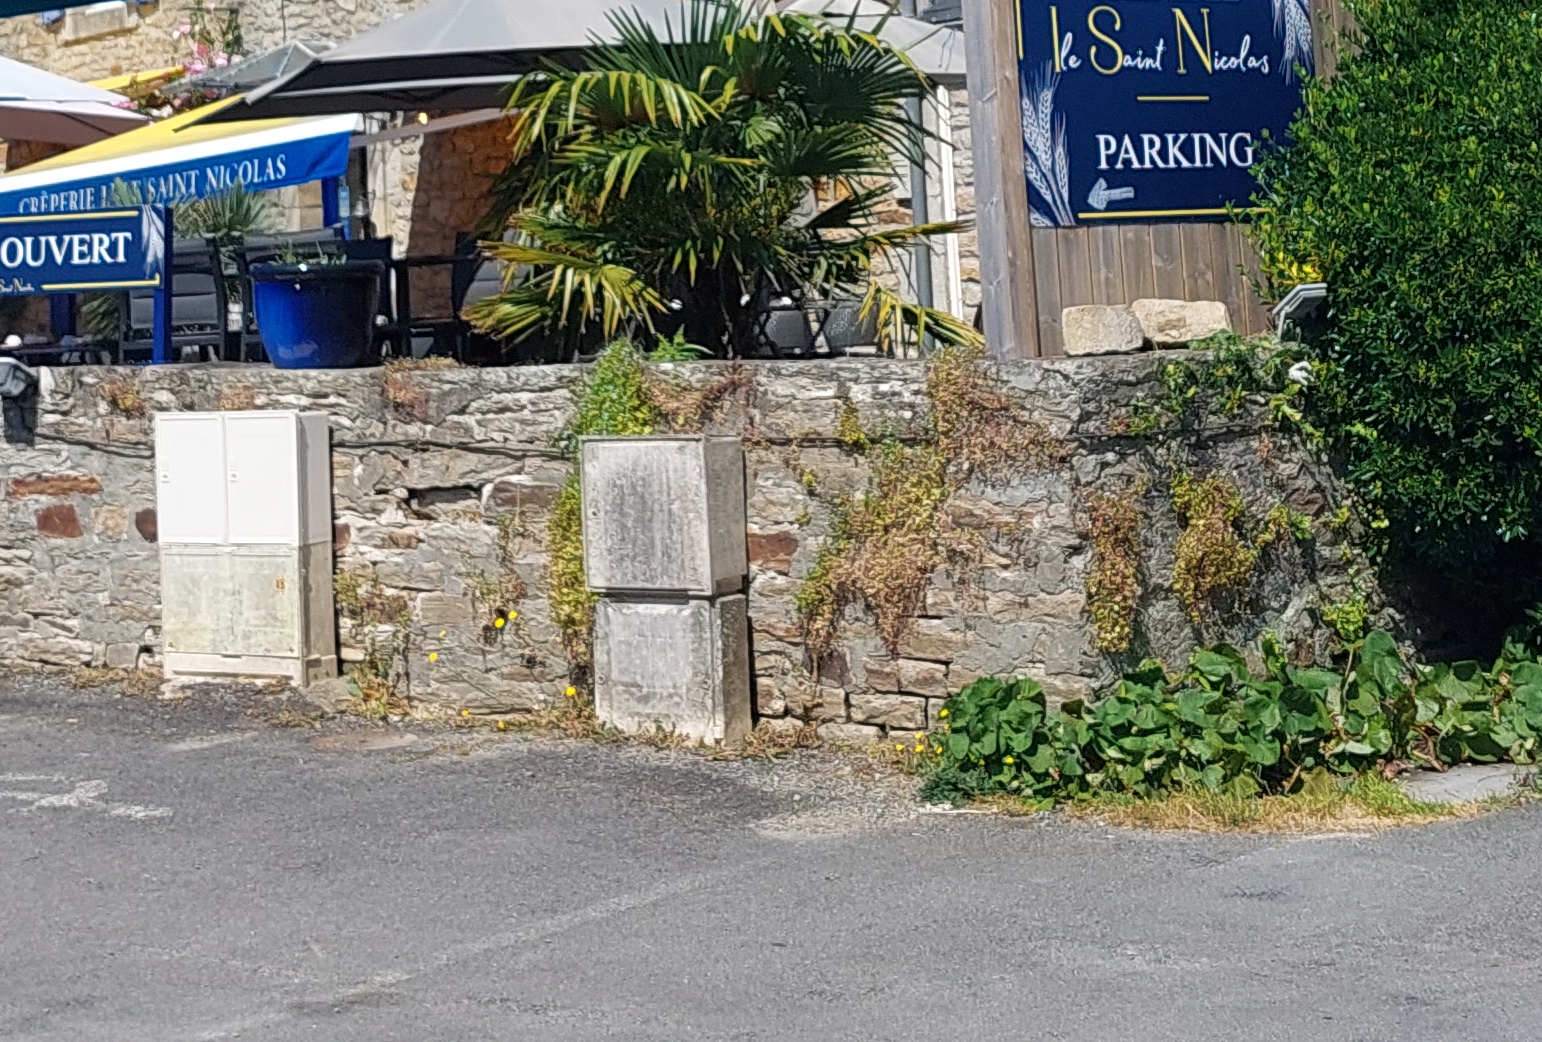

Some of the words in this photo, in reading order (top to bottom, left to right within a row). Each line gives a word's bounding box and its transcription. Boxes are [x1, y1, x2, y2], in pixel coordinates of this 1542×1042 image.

[1087, 5, 1167, 75] Saint
[1171, 8, 1269, 75] Nicolas
[1095, 132, 1254, 170] PARKING
[147, 169, 200, 206] SAINT
[205, 154, 287, 191] NICOLAS
[0, 232, 132, 268] OUVERT
